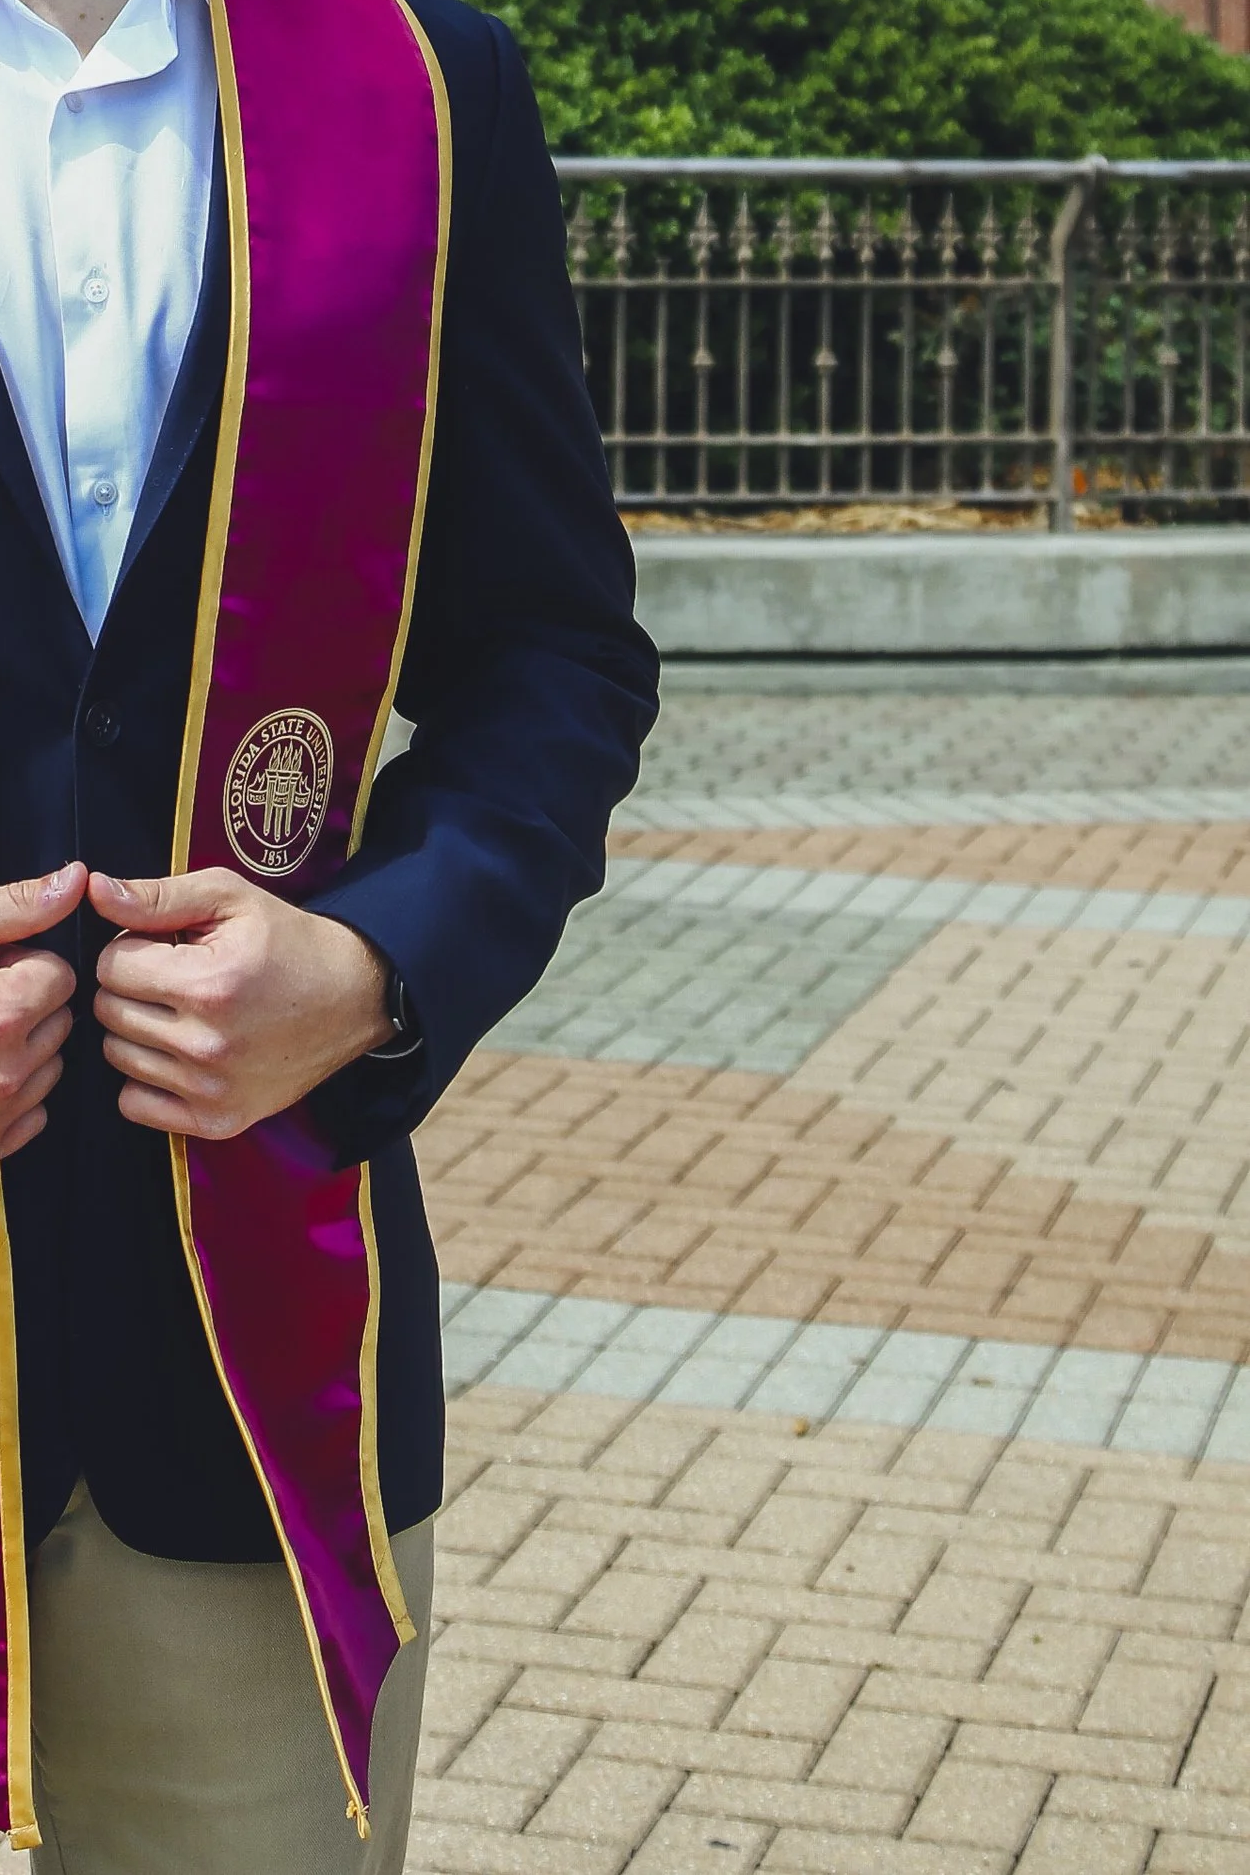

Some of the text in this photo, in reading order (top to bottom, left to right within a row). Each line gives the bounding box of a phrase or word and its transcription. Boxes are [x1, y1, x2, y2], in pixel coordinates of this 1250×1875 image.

[230, 718, 327, 838] FLORIDA STATE UNIVERSITY
[261, 849, 289, 866] 1851
